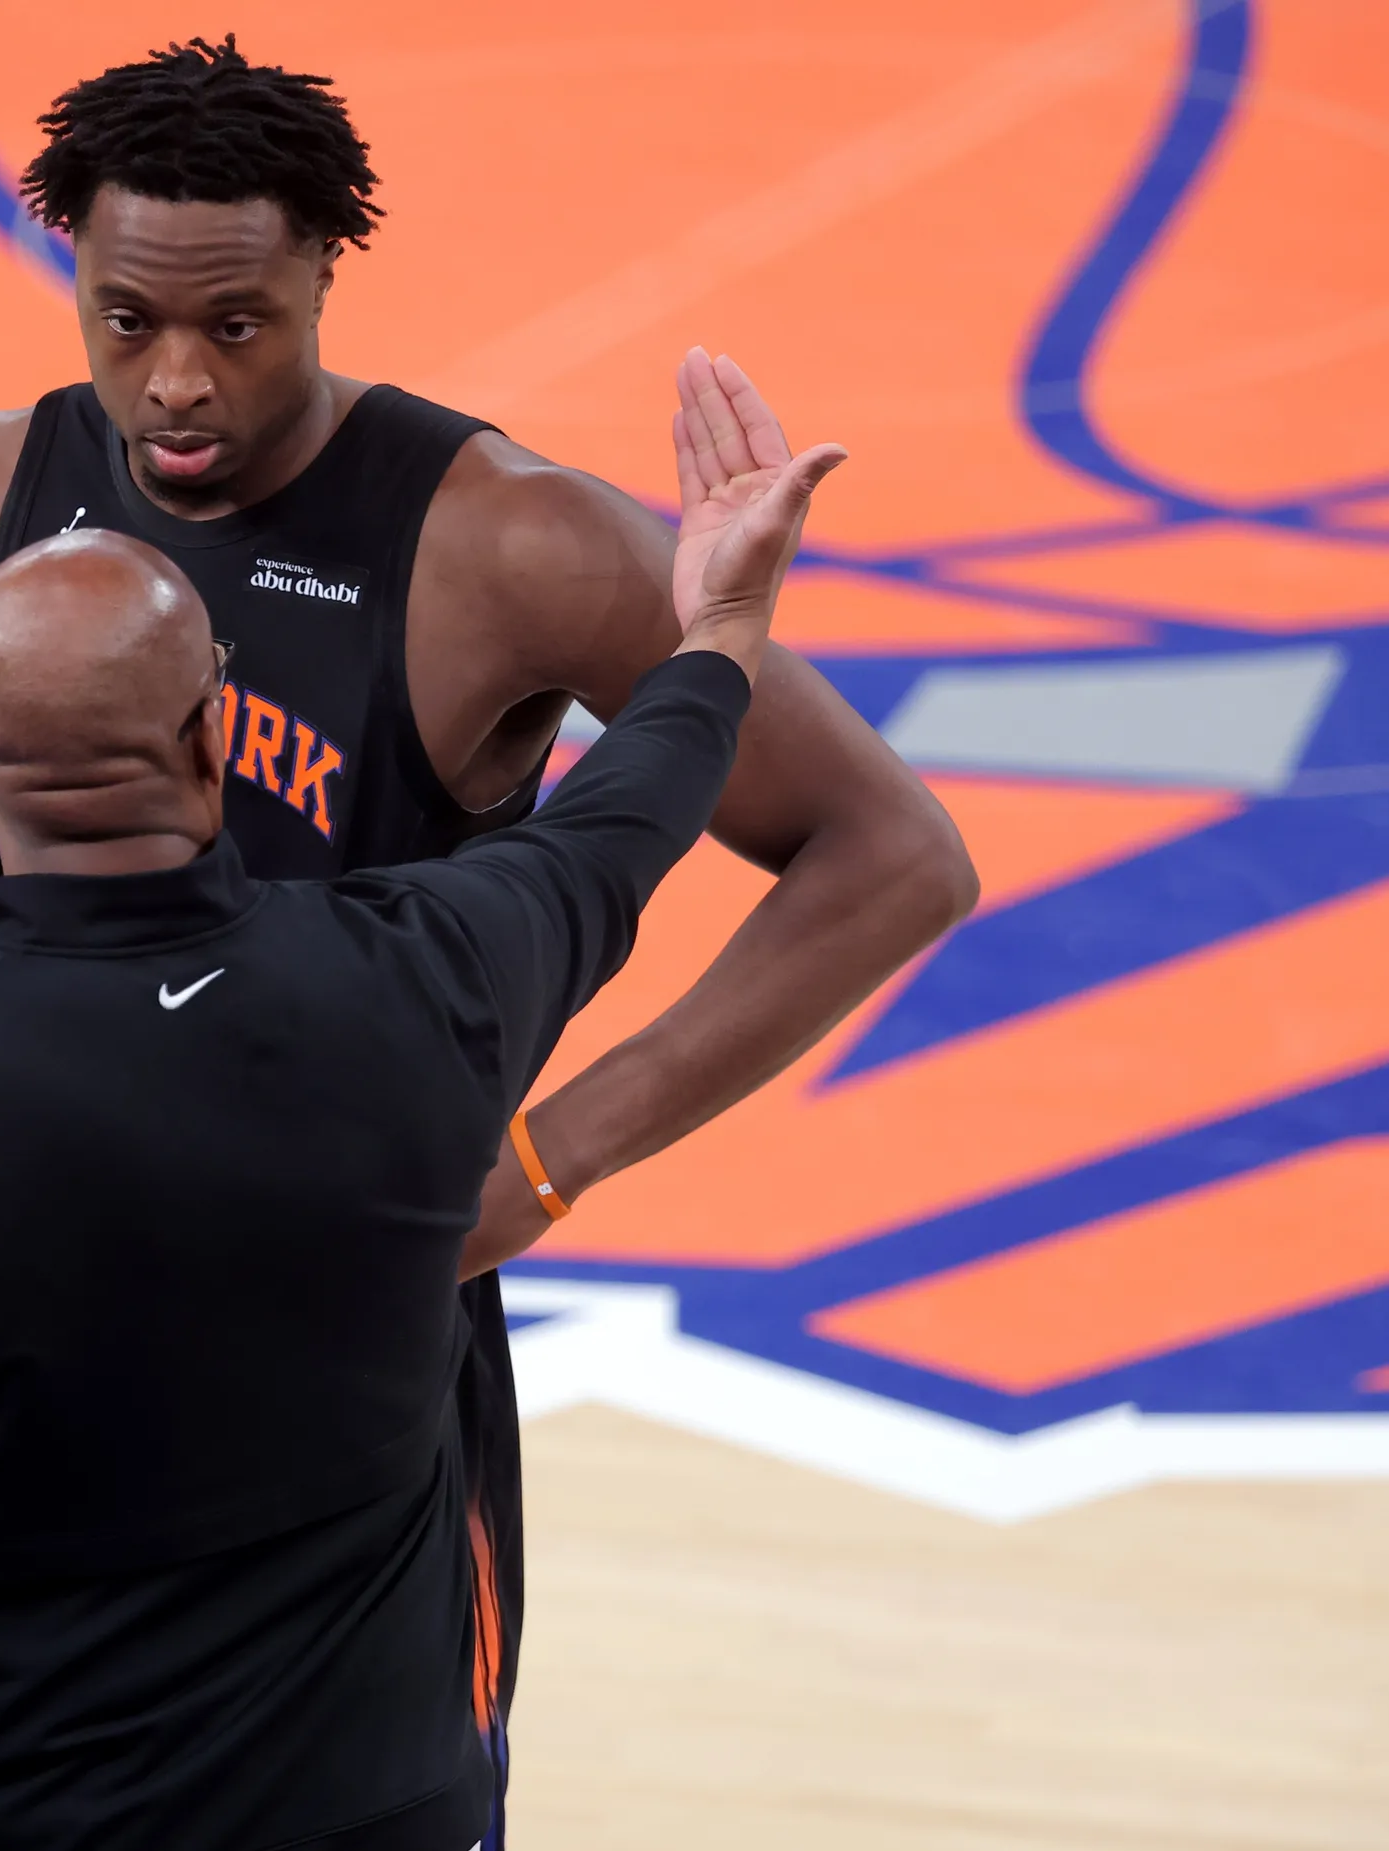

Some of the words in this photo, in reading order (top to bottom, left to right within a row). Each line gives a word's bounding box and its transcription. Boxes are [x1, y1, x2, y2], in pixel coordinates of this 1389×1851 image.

[256, 557, 314, 576] experience
[250, 570, 293, 593] abu
[295, 576, 361, 605] dhabi
